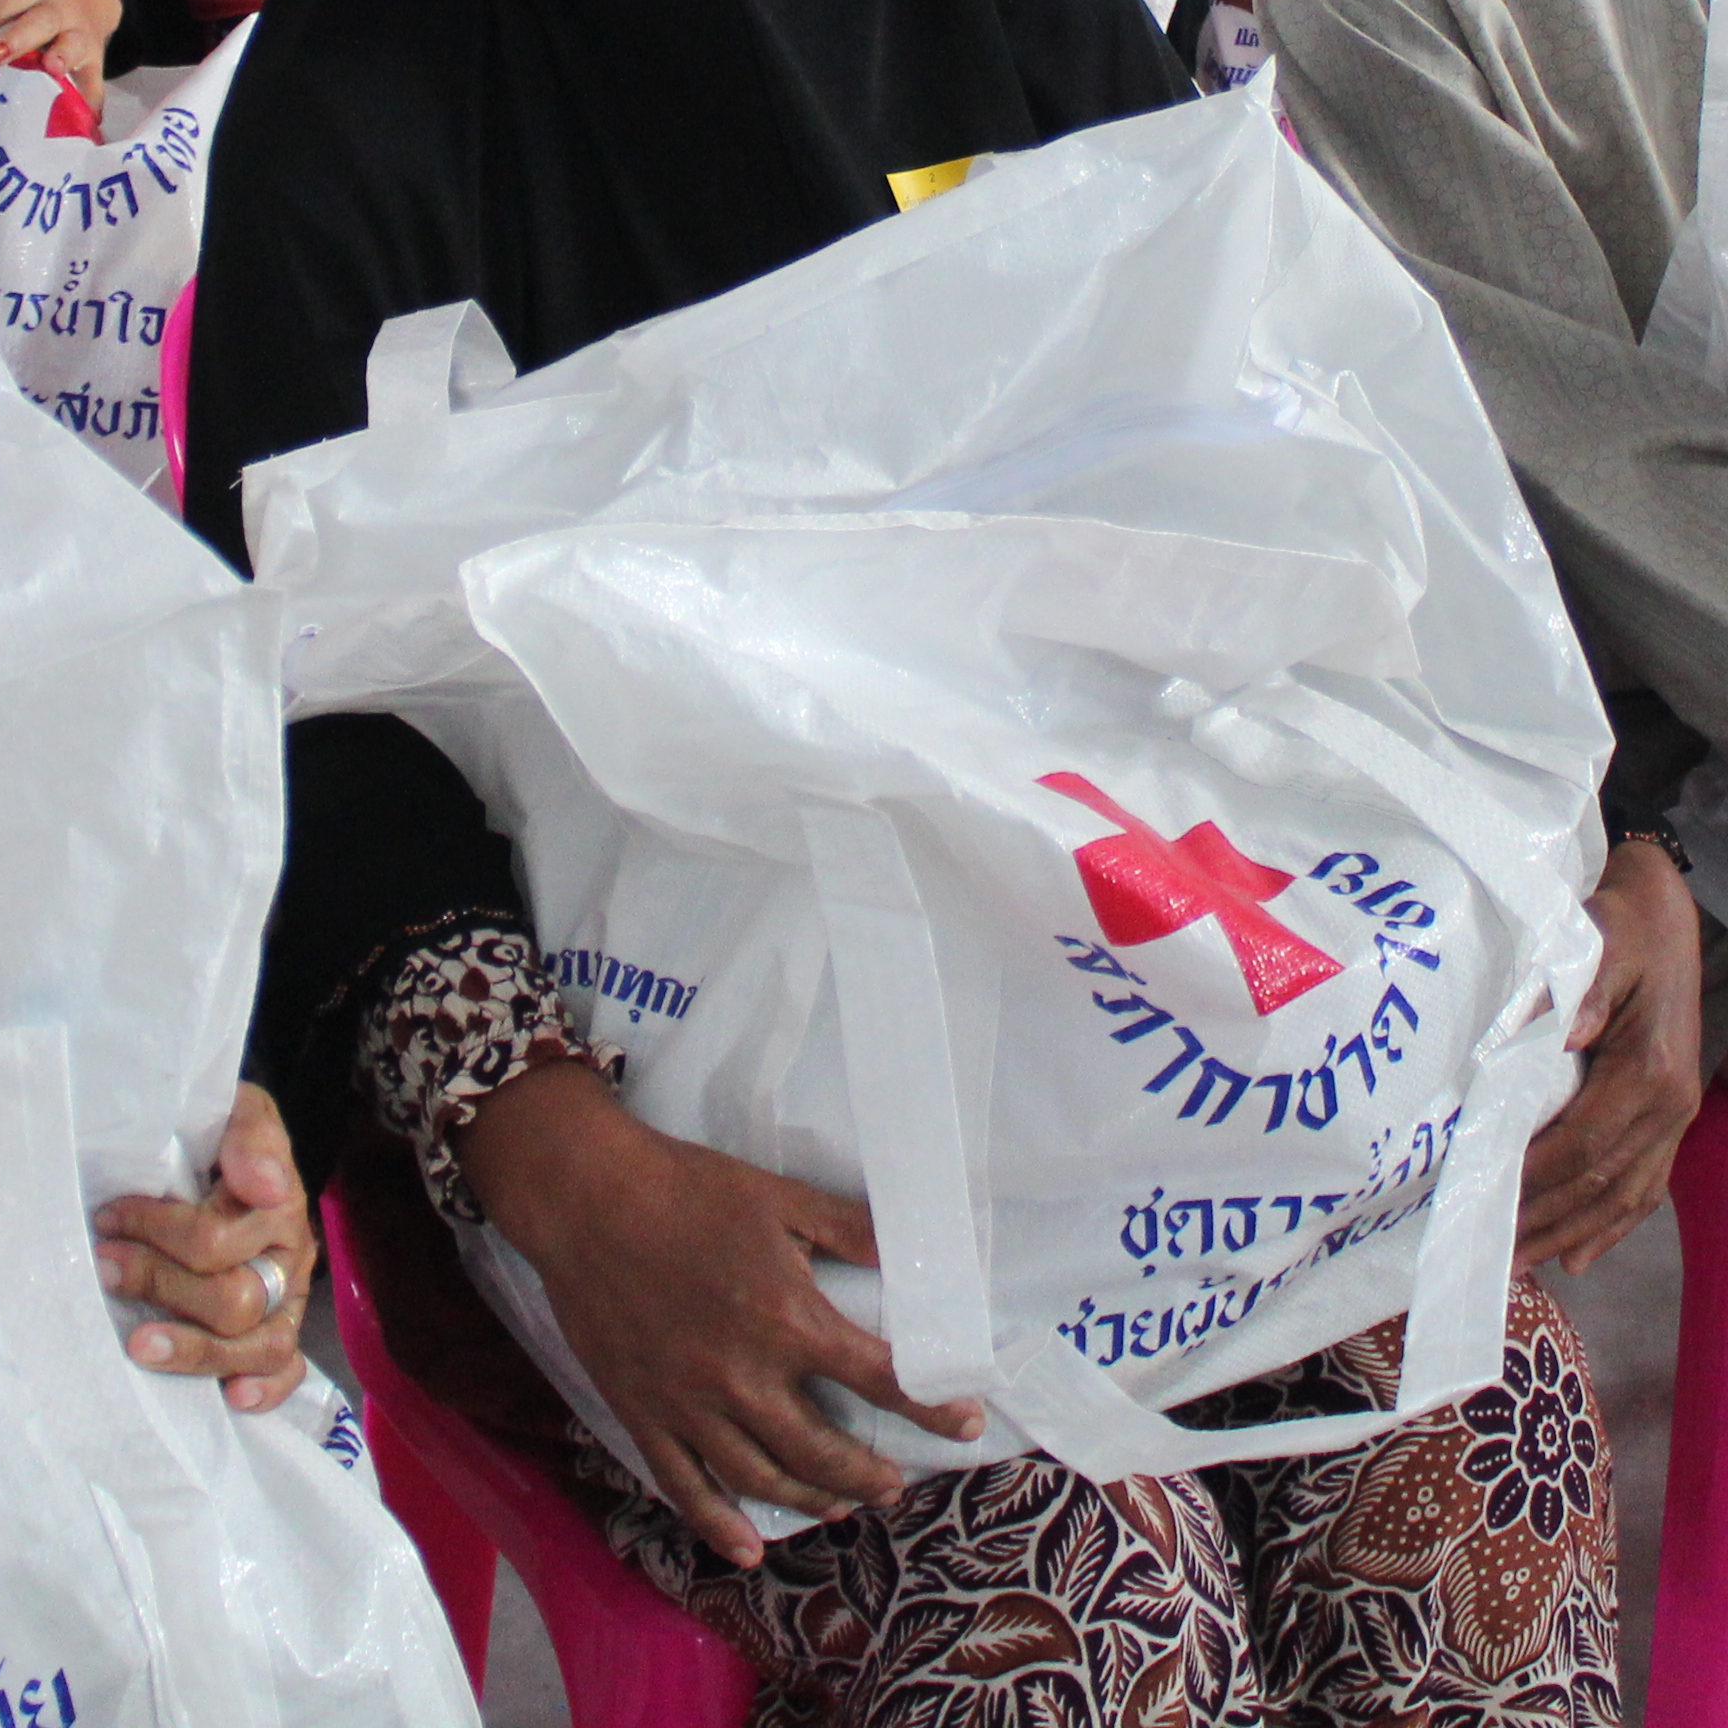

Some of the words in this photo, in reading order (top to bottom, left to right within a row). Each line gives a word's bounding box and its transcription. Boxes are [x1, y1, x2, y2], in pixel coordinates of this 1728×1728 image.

[1053, 852, 1441, 1134] สภากาชาดไทย
